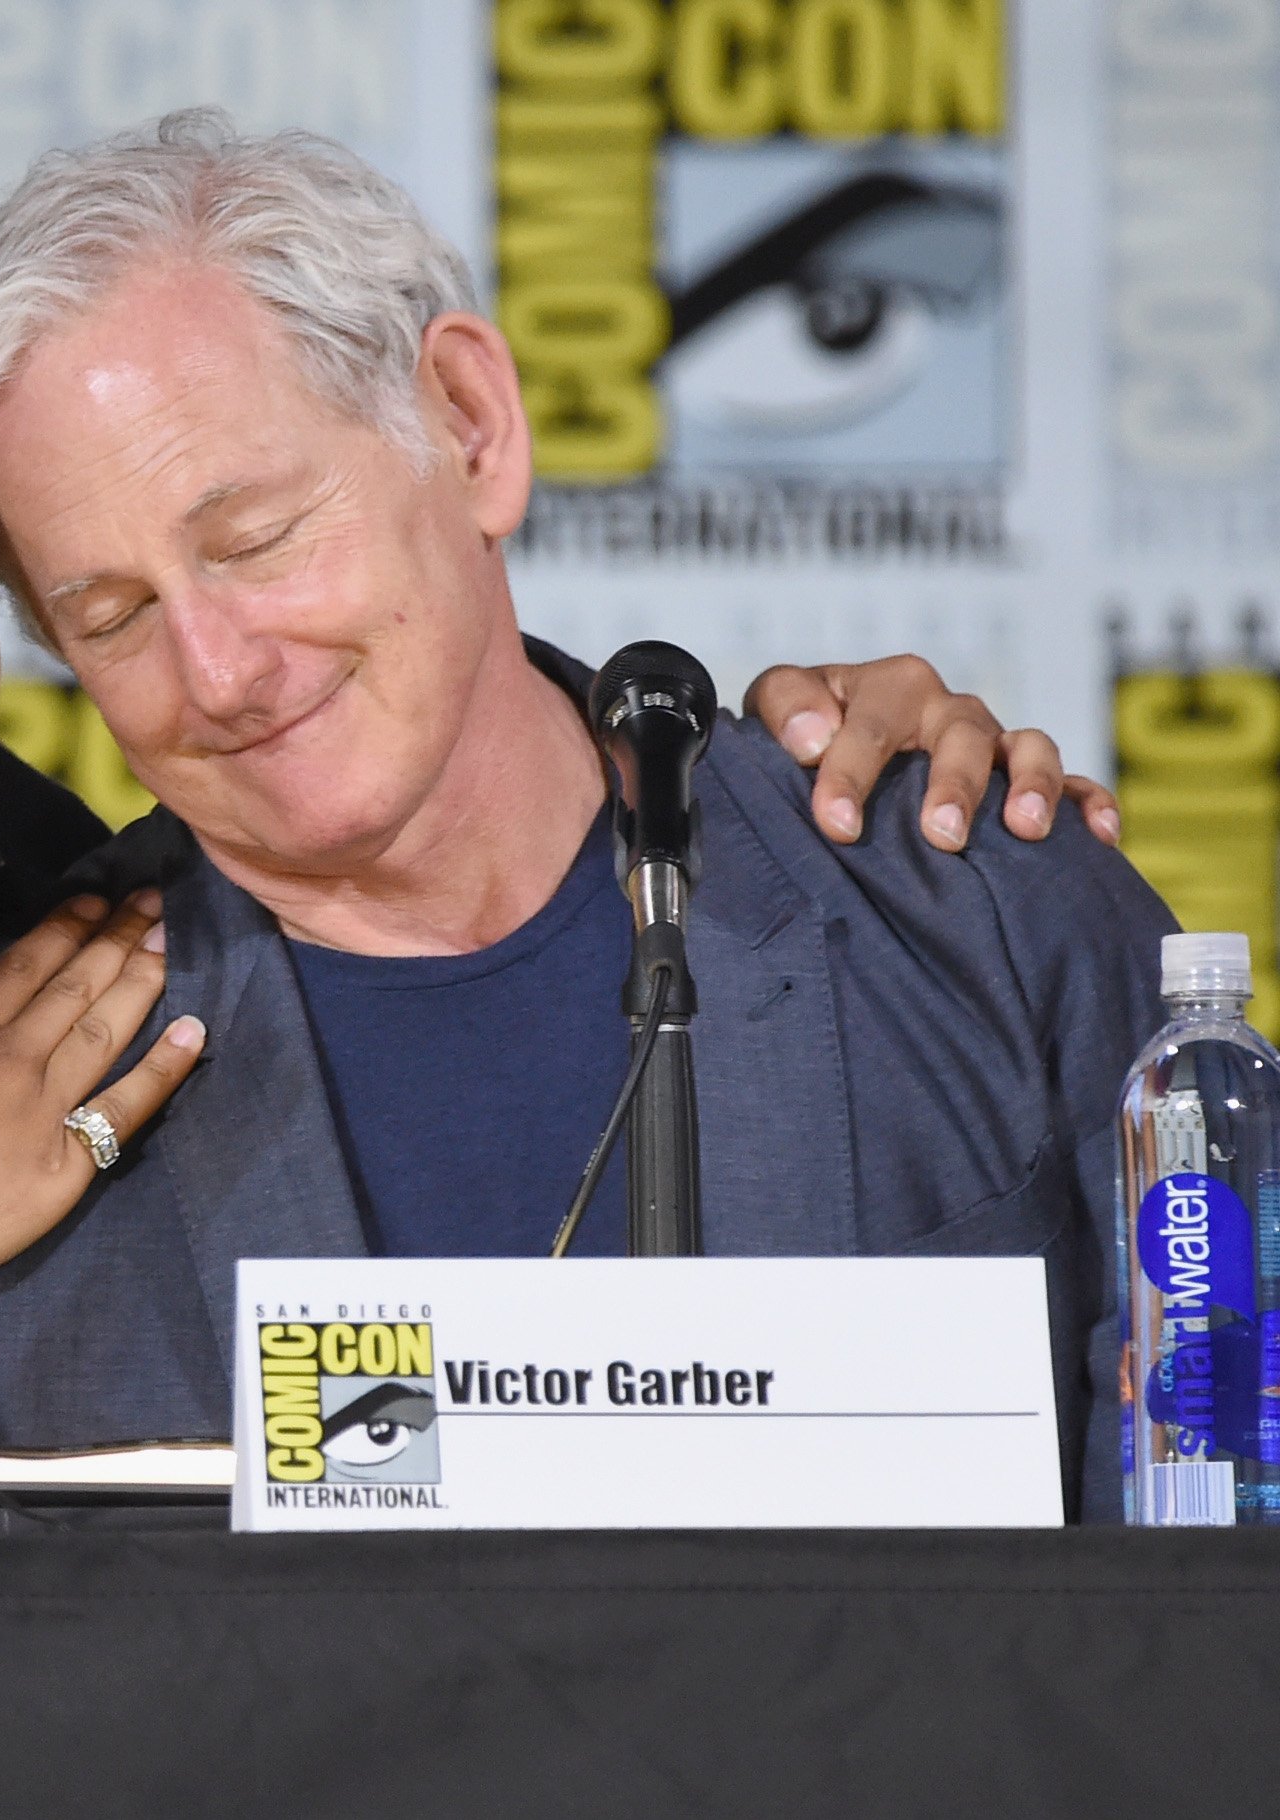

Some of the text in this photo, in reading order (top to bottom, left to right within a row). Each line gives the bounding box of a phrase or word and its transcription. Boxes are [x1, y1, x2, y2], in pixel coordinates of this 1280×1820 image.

[668, 0, 1005, 140] CON
[256, 1304, 432, 1318] SAN DIEGO
[321, 1322, 434, 1376] CON
[259, 1323, 326, 1482] COMIC
[443, 1360, 774, 1406] Victor Garber
